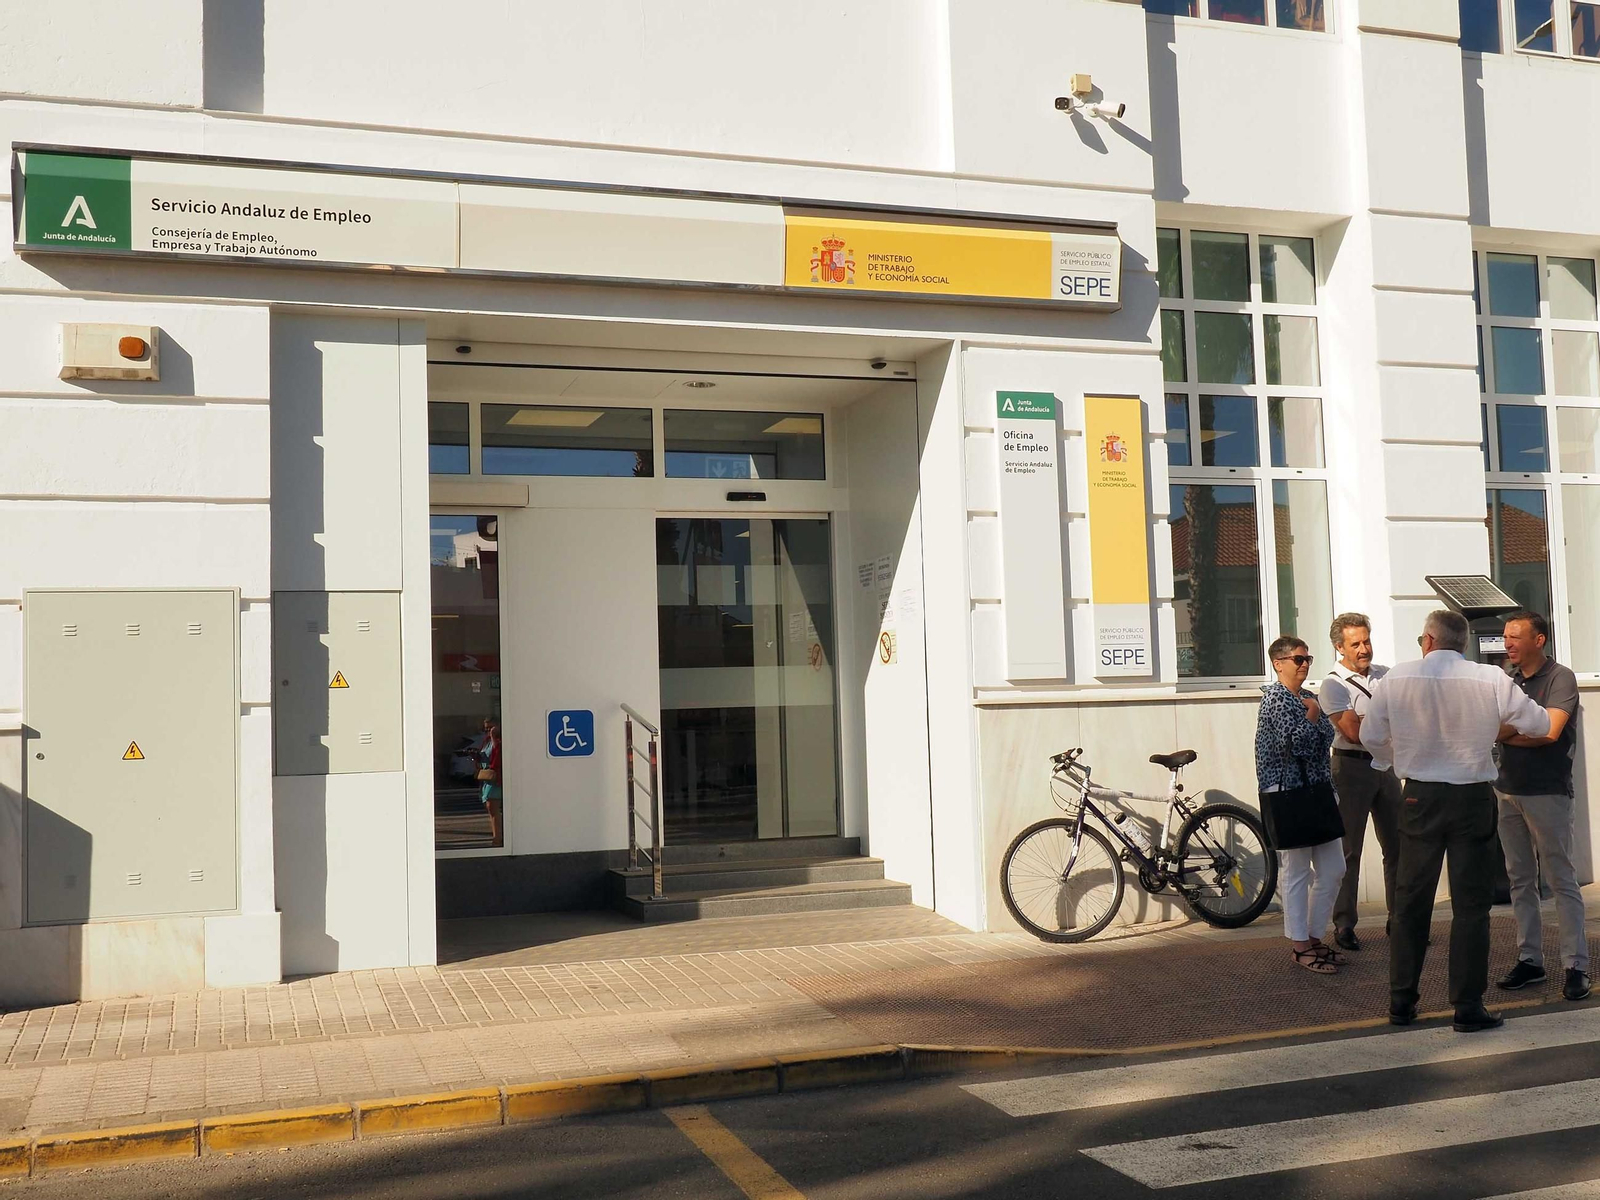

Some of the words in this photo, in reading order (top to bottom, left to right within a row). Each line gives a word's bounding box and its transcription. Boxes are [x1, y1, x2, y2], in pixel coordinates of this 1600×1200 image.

[151, 198, 217, 214] Servicio
[221, 202, 286, 219] Andaluz
[290, 206, 309, 220] de
[313, 208, 371, 225] Empleo
[43, 232, 65, 240] Junta
[66, 233, 77, 241] de
[77, 234, 116, 243] Andalucía
[151, 226, 212, 240] Consejería
[215, 230, 229, 239] de
[232, 231, 278, 244] Empleo,
[152, 239, 202, 251] Empresa
[204, 244, 211, 253] y
[214, 242, 256, 255] Trabajo
[259, 245, 317, 257] Autónomo
[868, 254, 913, 263] MINISTERIO
[1060, 250, 1086, 258] SERVICIO
[1087, 252, 1112, 260] PÚBLICO
[868, 263, 879, 271] DE
[880, 264, 915, 274] TRABAJO
[875, 273, 920, 283] ECONOMÍA
[921, 275, 950, 284] SOCIAL
[1060, 275, 1112, 297] SEPE
[1003, 430, 1034, 440] Oficina
[1003, 442, 1015, 451] de
[1016, 443, 1049, 453] Empleo
[1005, 460, 1029, 468] Servicio
[1101, 648, 1146, 666] SEPE
